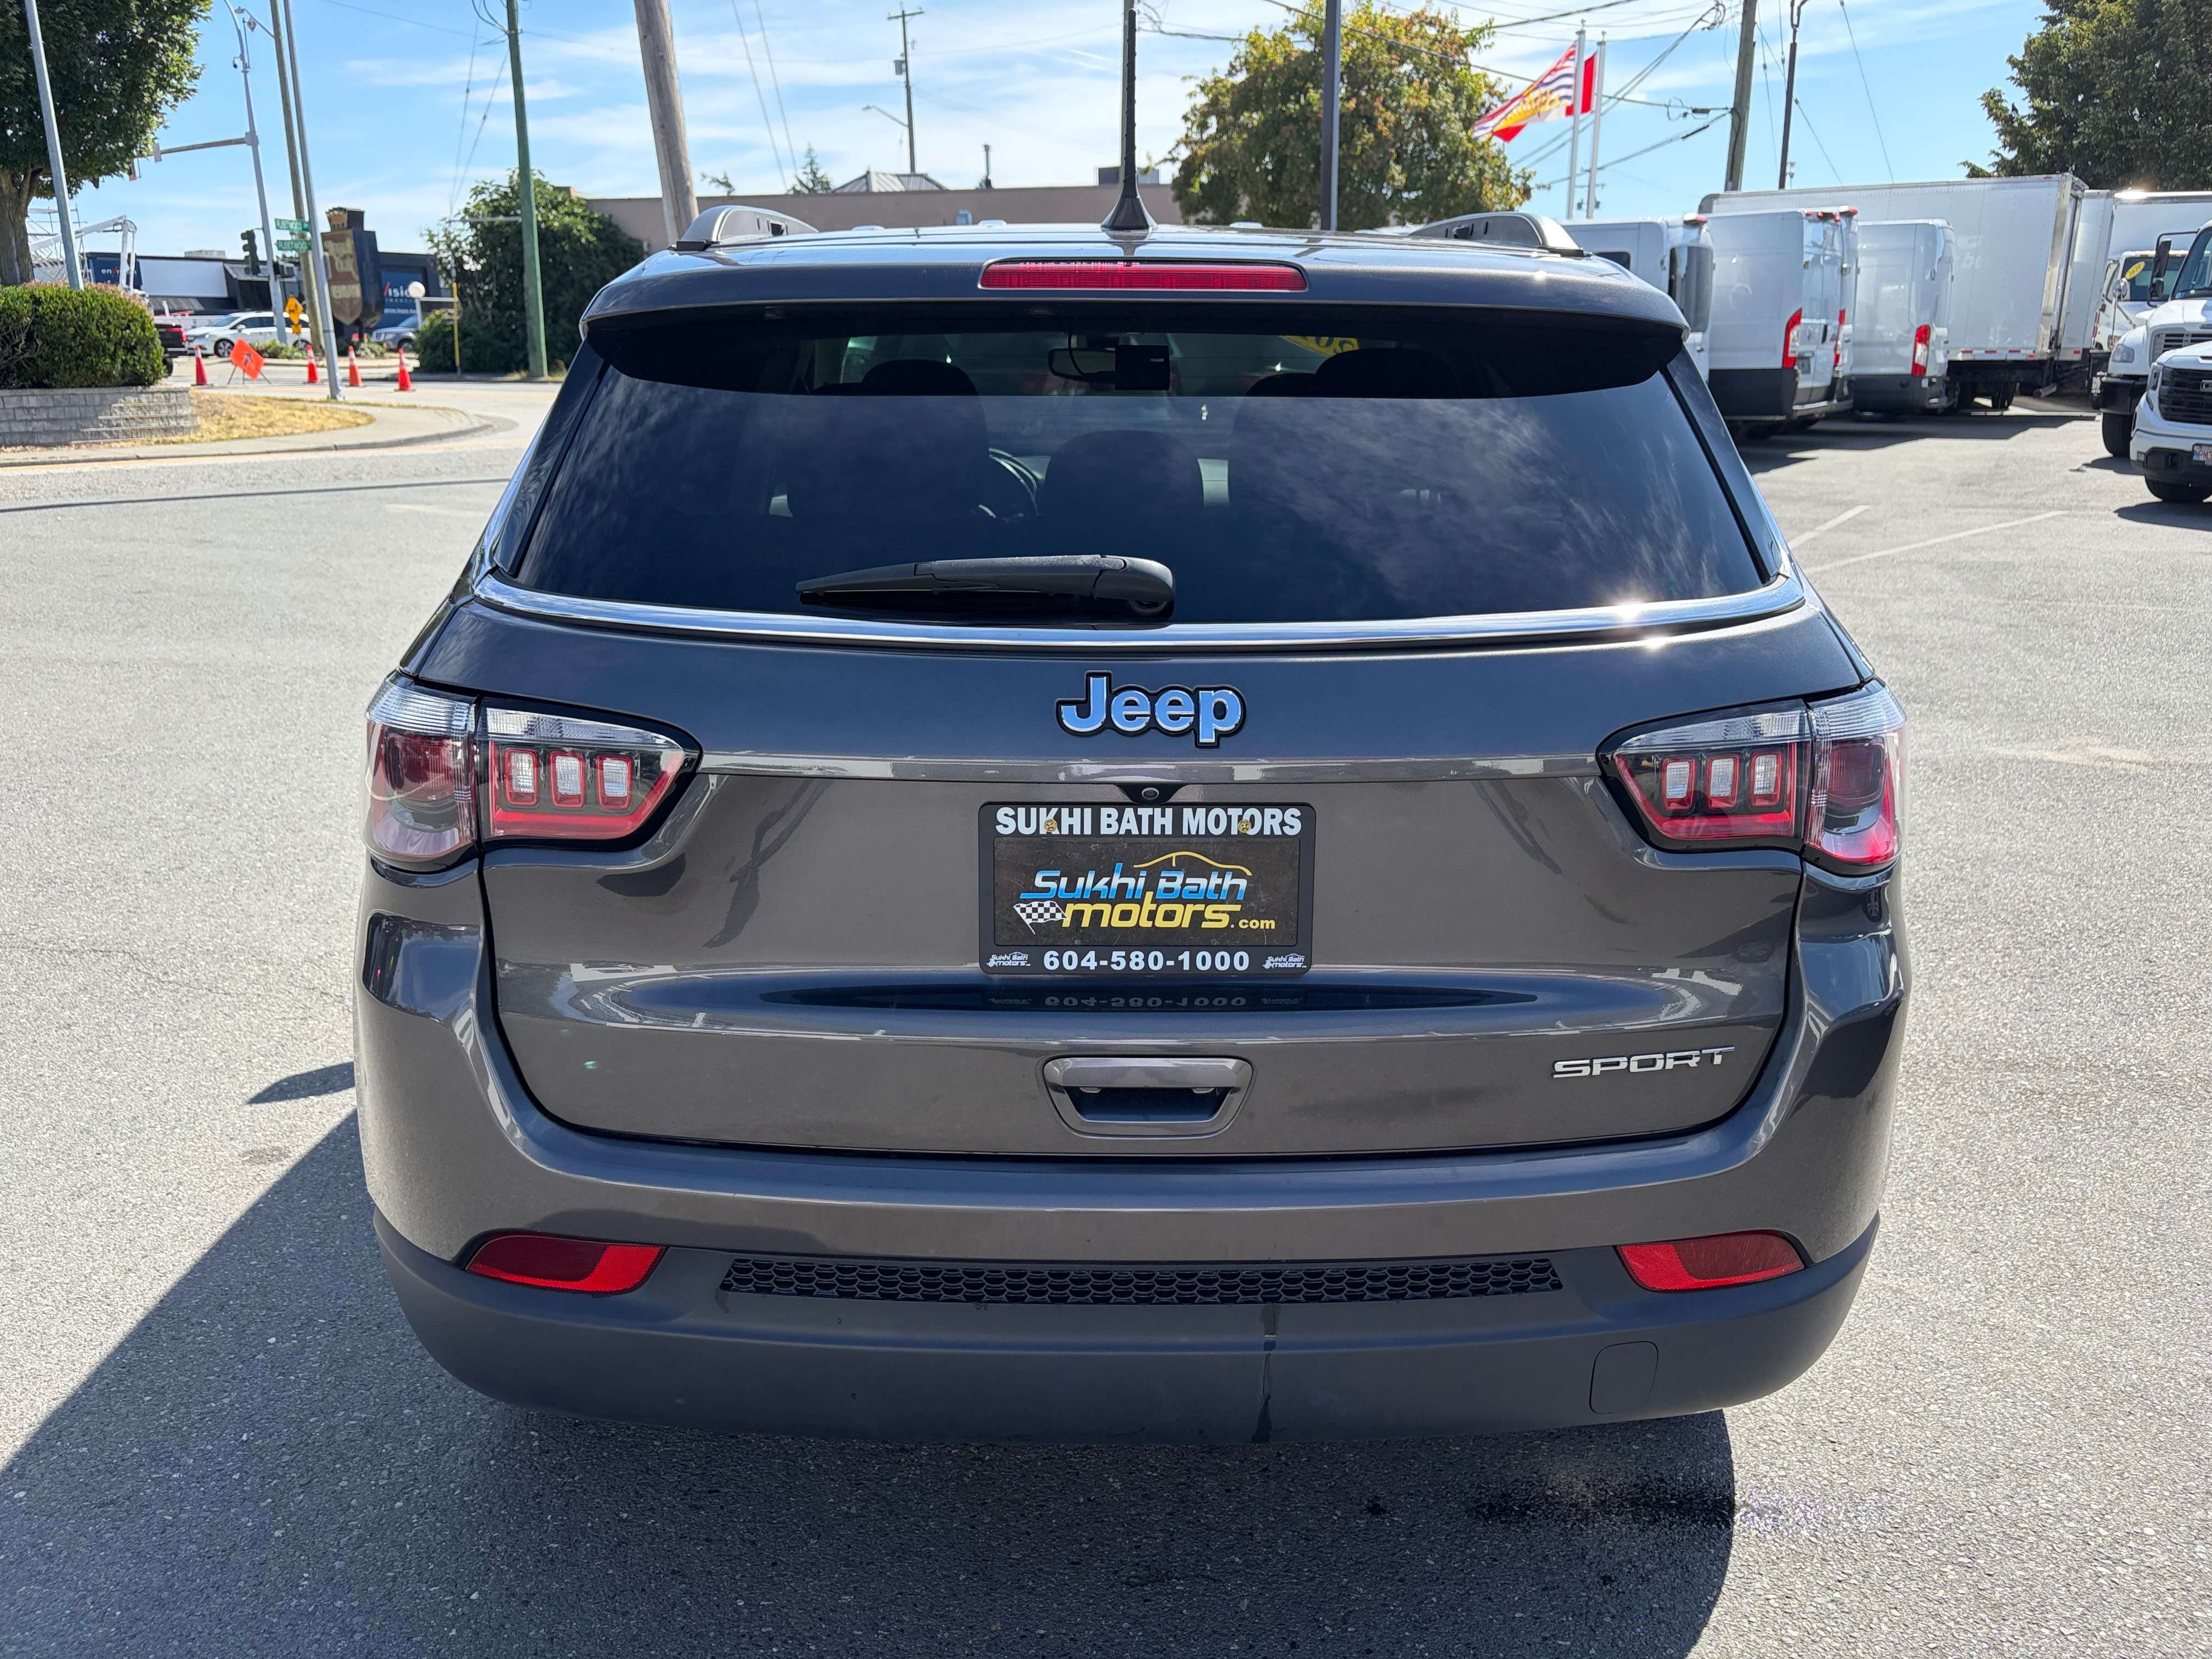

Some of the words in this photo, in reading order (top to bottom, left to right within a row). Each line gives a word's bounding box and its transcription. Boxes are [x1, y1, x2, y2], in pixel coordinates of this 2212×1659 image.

[1059, 675, 1243, 744] Jeep
[995, 807, 1092, 835] SUKHI
[1100, 807, 1173, 835] BATH
[1182, 808, 1302, 836] MOTORS
[1019, 862, 1147, 900] Sukhi
[1155, 871, 1249, 900] Bath
[1043, 950, 1250, 972] 604-580-1000
[1551, 1045, 1735, 1079] SPORT
